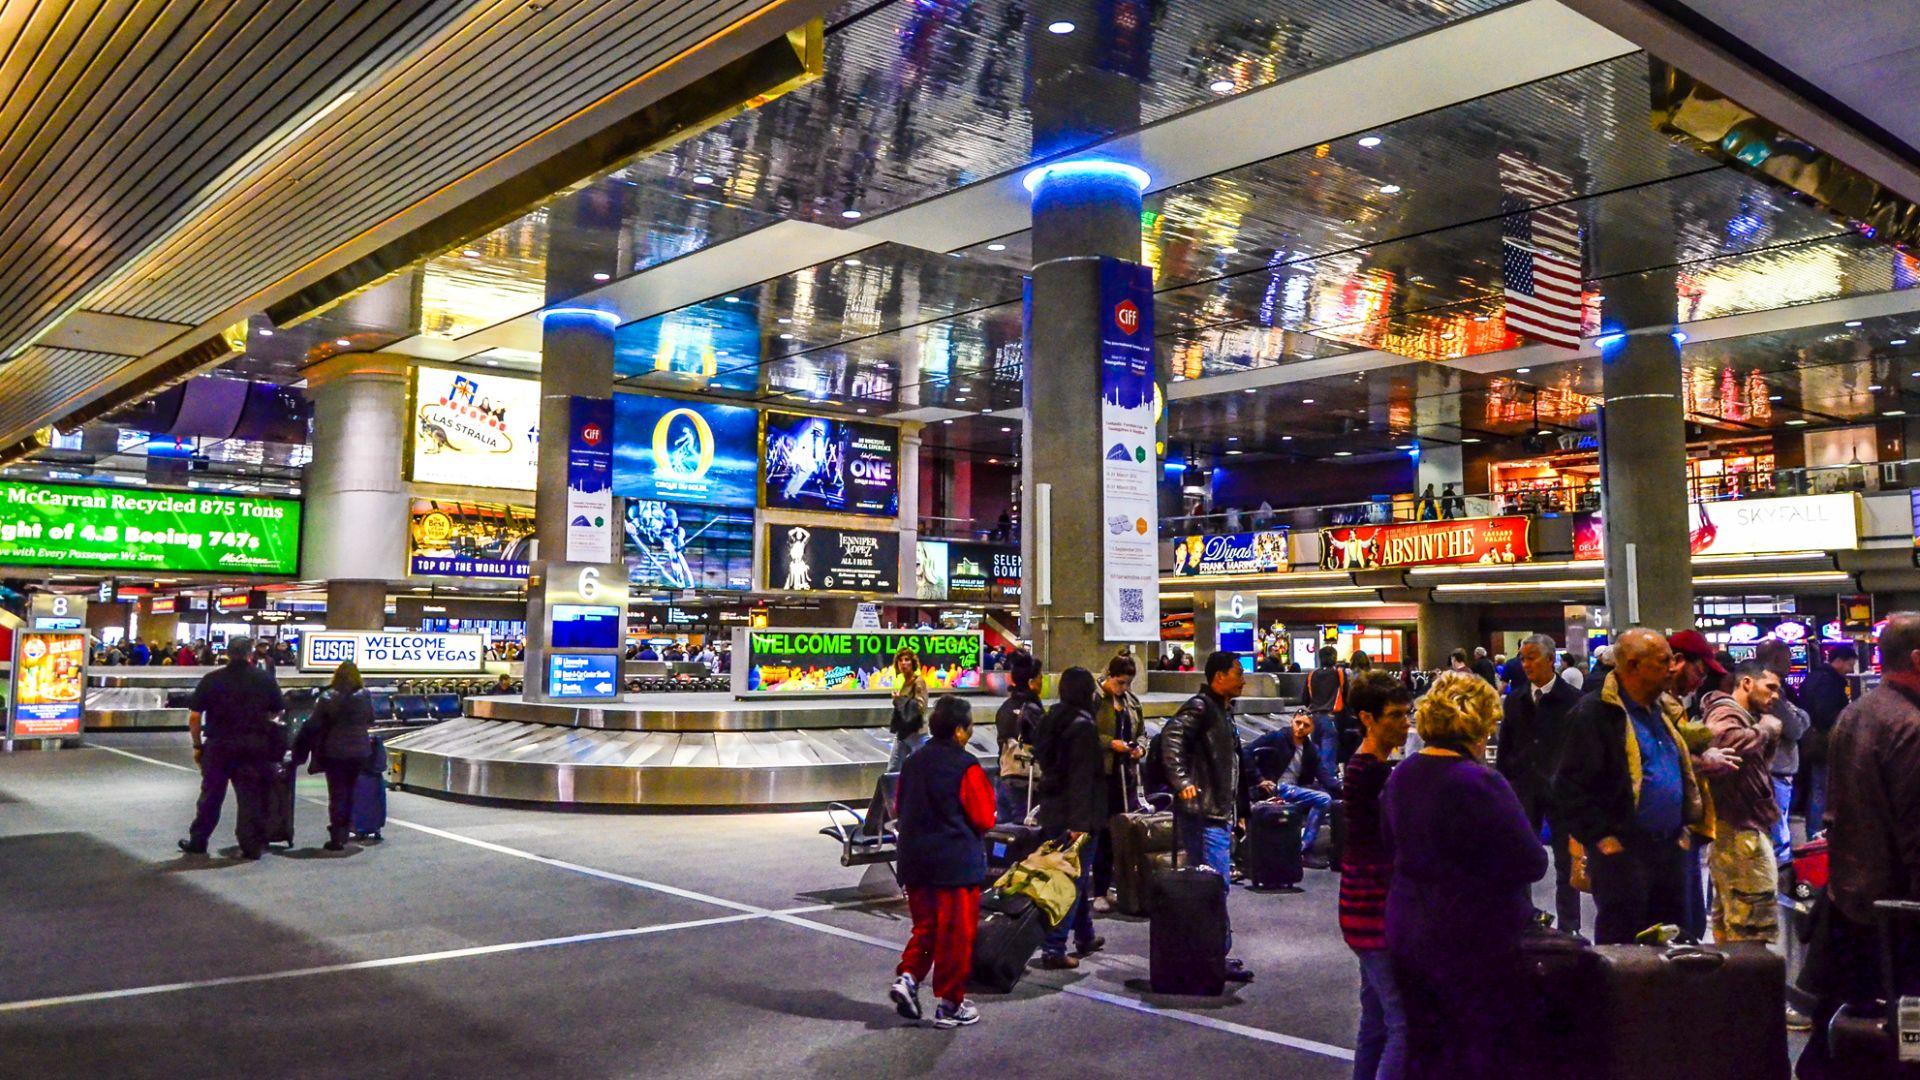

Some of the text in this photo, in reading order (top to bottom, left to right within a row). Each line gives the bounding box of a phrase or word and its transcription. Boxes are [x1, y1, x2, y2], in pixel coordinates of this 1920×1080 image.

[1119, 308, 1137, 325] Ciff
[433, 413, 497, 448] LAS STRALIA
[584, 428, 600, 440] Ciff
[652, 408, 715, 480] O
[868, 444, 892, 452] EXPERIENCE
[850, 459, 892, 480] ONE
[655, 481, 678, 491] CIRQUE
[688, 484, 709, 492] SOLEIL
[854, 478, 869, 486] CIRQUE
[8, 487, 284, 518] McCarran Recycled 875 Tons
[428, 519, 445, 528] Best
[1737, 503, 1832, 526] SKYFALL
[0, 520, 260, 549] ight of 4.5 Boeing 747s
[839, 531, 879, 550] JENNIFER
[12, 547, 36, 557] with
[37, 548, 67, 560] Every
[68, 549, 119, 562] Passenger
[120, 551, 137, 561] We
[137, 552, 165, 562] Serve
[844, 543, 873, 558] LOPEZ
[1203, 535, 1254, 561] Divas
[1382, 528, 1475, 566] ABSINTHE
[418, 560, 436, 570] TOP
[439, 561, 451, 571] OF
[455, 562, 472, 572] THE
[475, 563, 506, 574] WORLD
[841, 558, 852, 566] ALL
[857, 558, 873, 566] HAVE
[1199, 560, 1257, 571] FRANK MARINO
[579, 566, 600, 600] 6
[1003, 586, 1017, 595] MAY
[52, 596, 69, 617] 8
[1231, 595, 1244, 618] 6
[962, 619, 971, 631] 7
[1594, 608, 1603, 627] 5
[322, 636, 446, 660] USO WELCOME
[751, 633, 980, 655] WELCOME TO LAS VEGAS
[365, 649, 477, 662] TO LAS VEGAS
